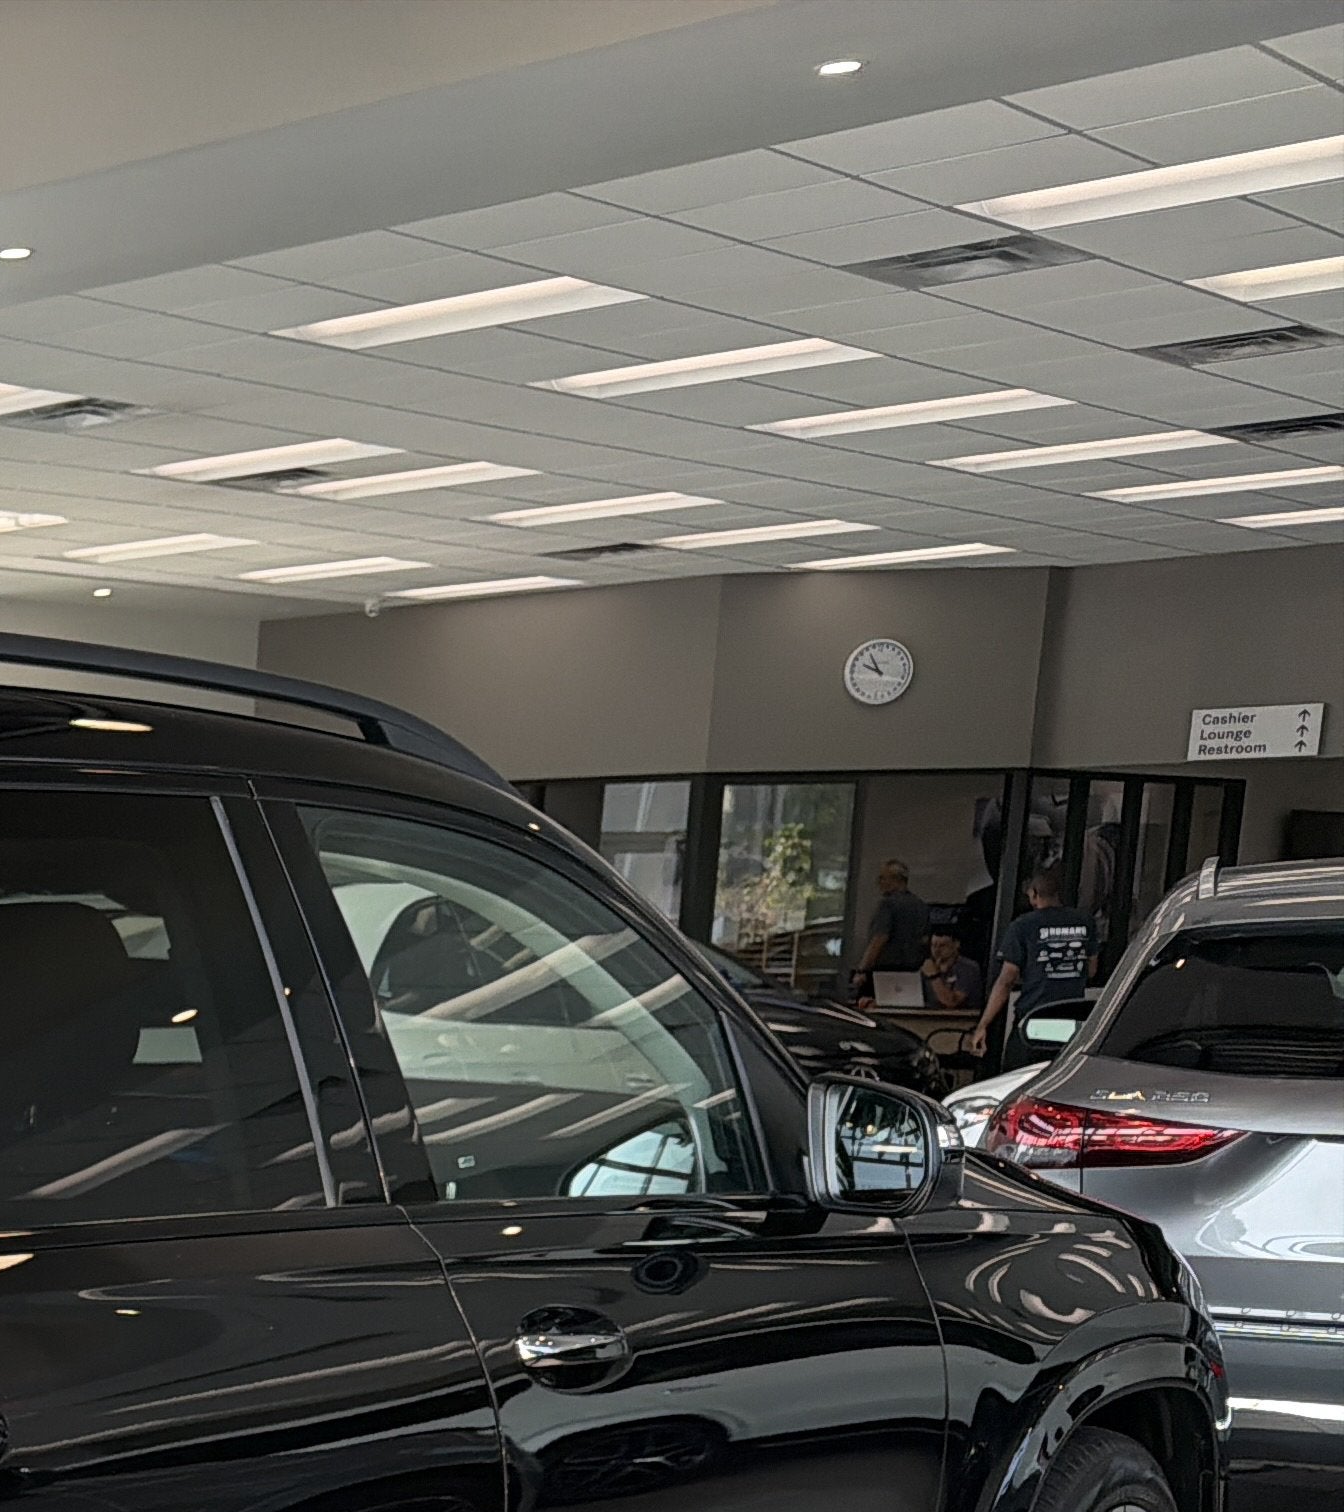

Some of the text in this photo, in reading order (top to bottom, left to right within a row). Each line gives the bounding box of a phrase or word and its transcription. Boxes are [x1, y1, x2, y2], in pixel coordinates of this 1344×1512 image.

[1202, 712, 1257, 726] Cashier
[1199, 729, 1252, 742] Lounge
[1197, 743, 1267, 756] Restroom
